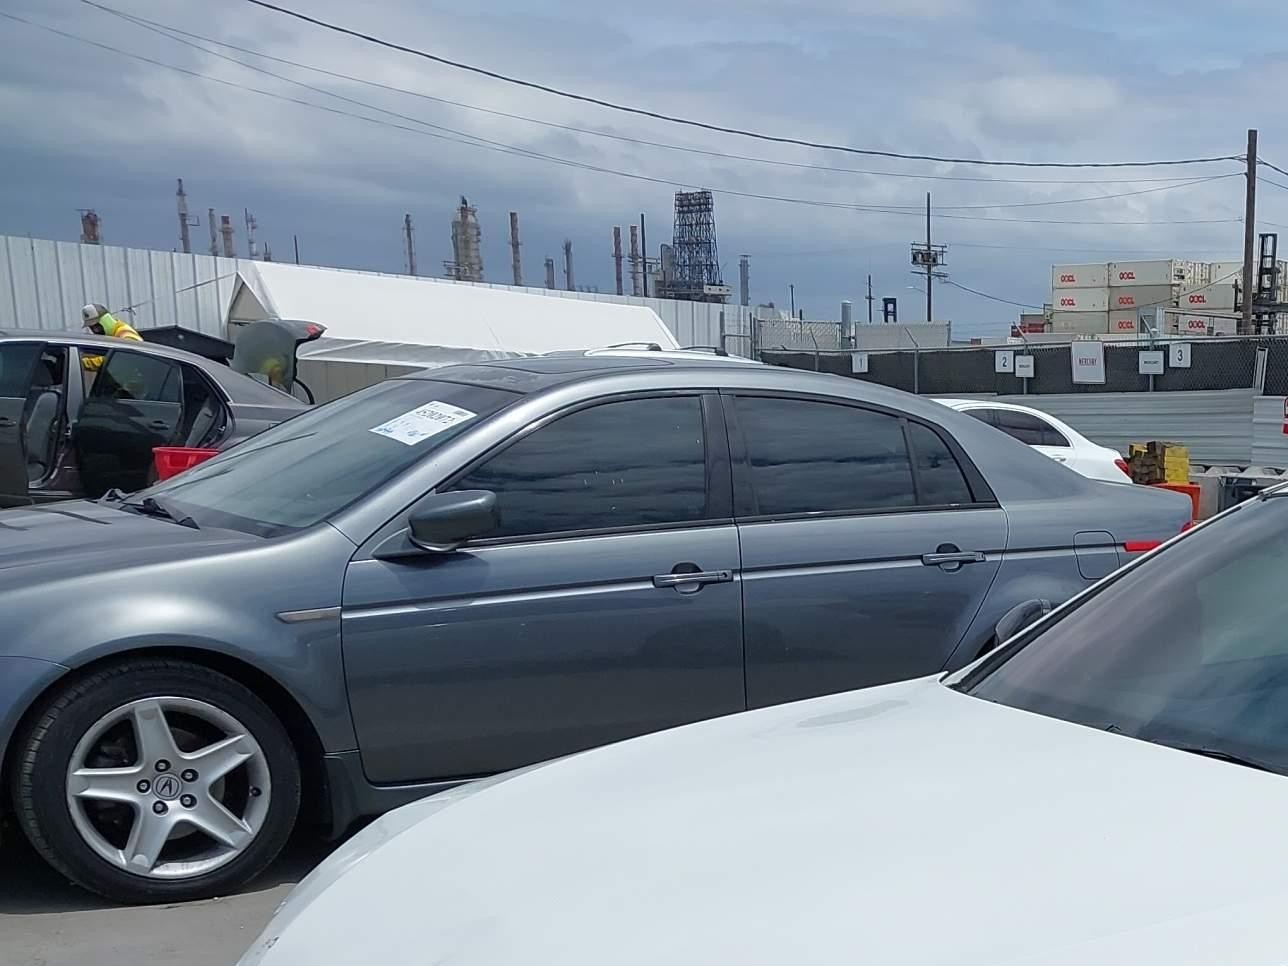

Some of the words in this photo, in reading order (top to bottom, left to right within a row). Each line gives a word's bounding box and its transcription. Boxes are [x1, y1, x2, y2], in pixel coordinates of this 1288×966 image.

[1060, 275, 1076, 283] OOCL
[1119, 272, 1136, 280] OOCL
[1118, 297, 1135, 305] OOCL
[1188, 295, 1206, 303] OOCL
[1118, 321, 1135, 329] OOCL
[1188, 320, 1206, 329] OOCL
[1177, 349, 1184, 362] 3
[1002, 356, 1008, 368] 2
